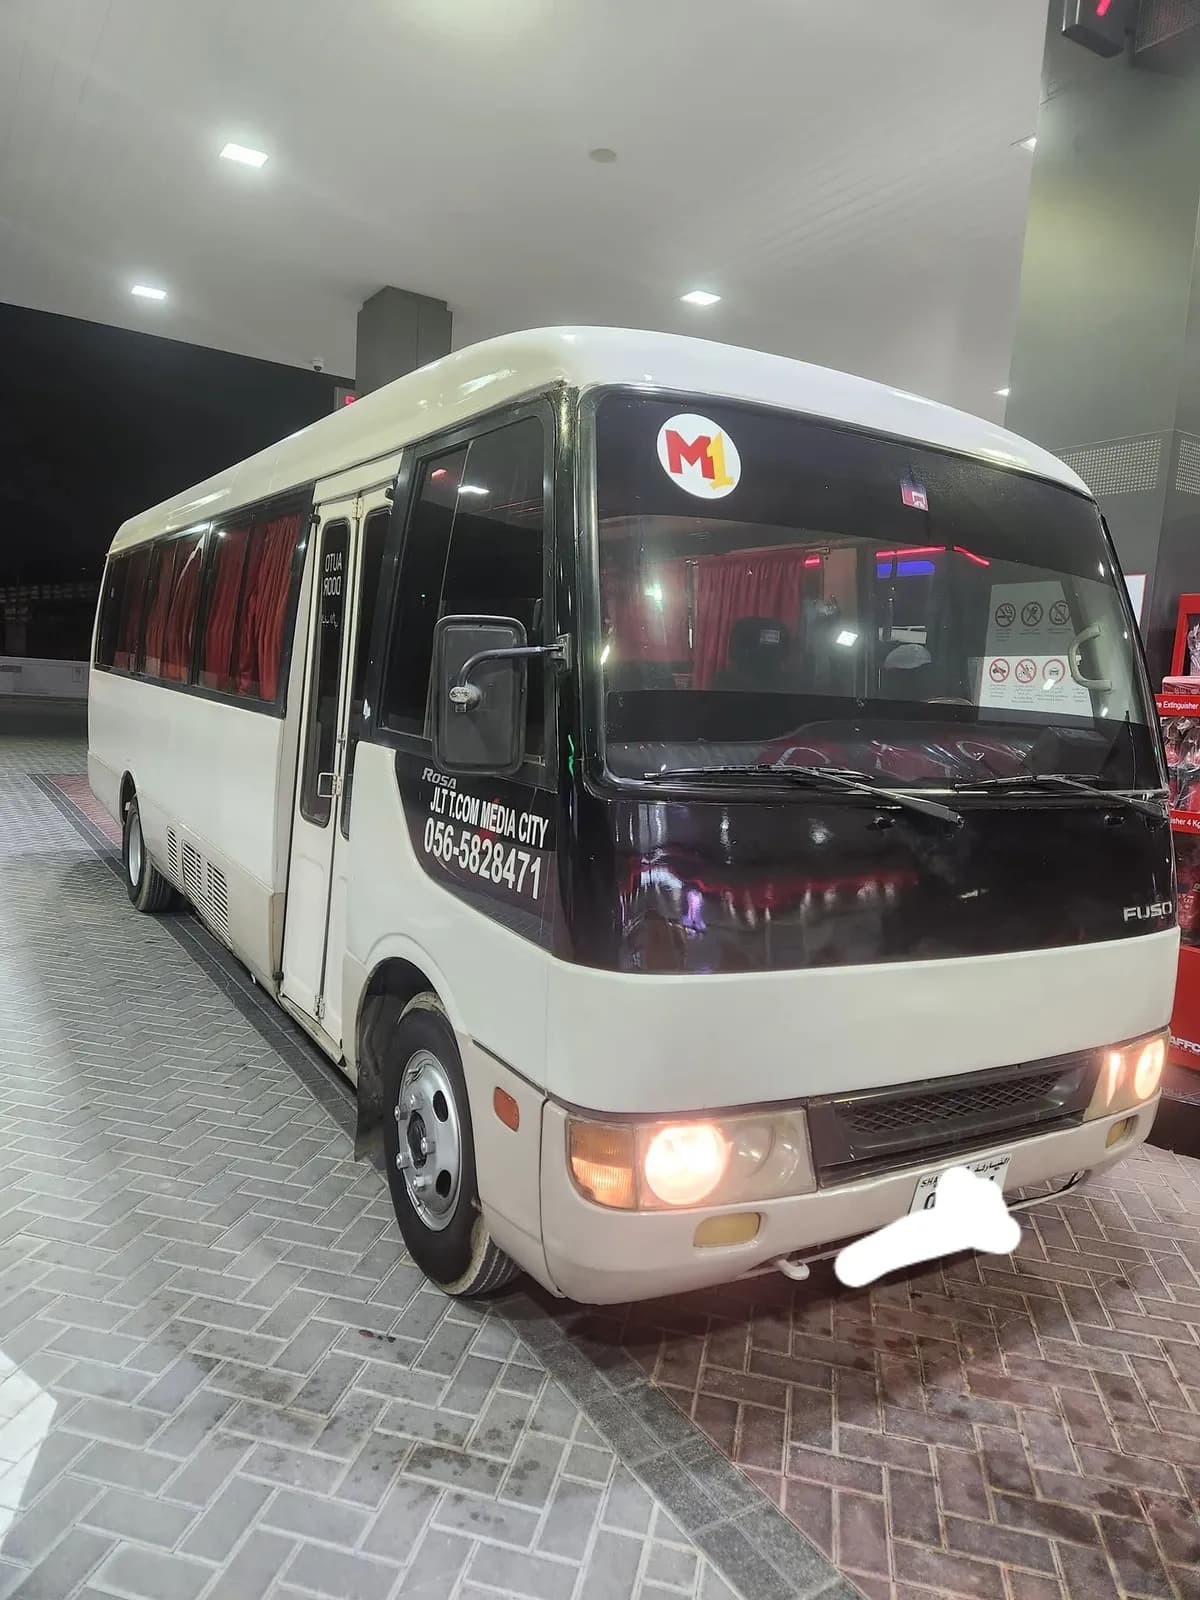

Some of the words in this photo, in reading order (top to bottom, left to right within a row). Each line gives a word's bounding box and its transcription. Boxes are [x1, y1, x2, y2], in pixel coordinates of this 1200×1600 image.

[665, 429, 734, 490] M1
[1163, 700, 1199, 711] Extinguisher
[479, 800, 516, 839] MEDIA
[518, 812, 549, 848] CITY
[424, 817, 542, 900] 056-5828471
[1123, 901, 1173, 922] FUSO
